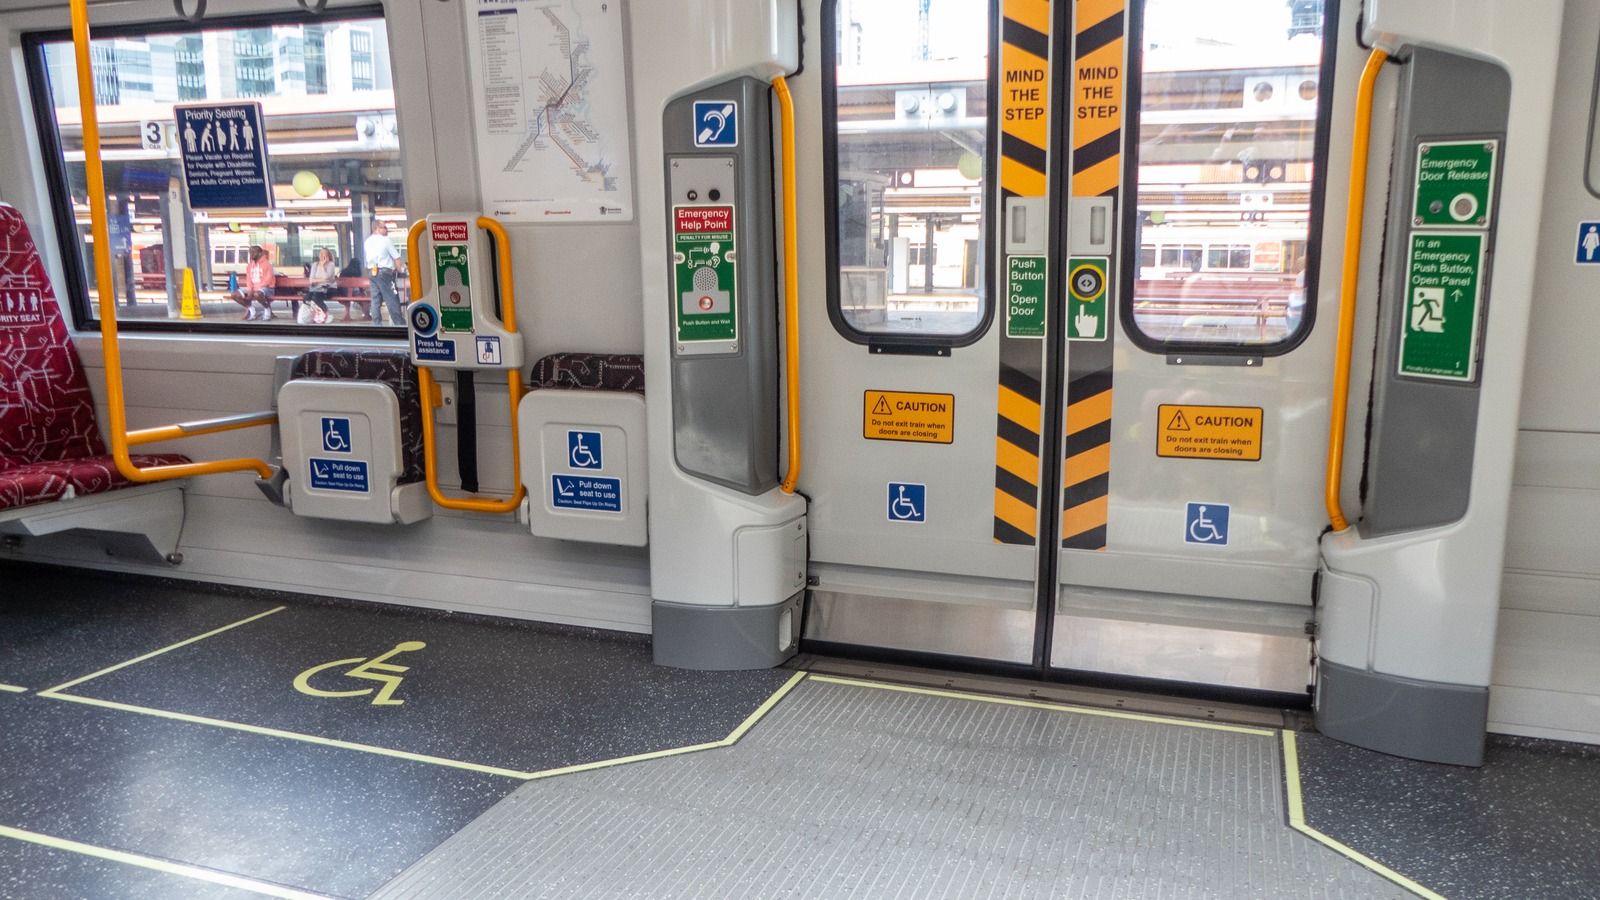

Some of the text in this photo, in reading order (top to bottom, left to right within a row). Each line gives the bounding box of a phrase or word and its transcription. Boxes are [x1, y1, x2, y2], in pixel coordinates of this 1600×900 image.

[1006, 70, 1044, 82] MIND
[1079, 66, 1118, 80] MIND
[1010, 89, 1040, 101] THE
[1082, 86, 1114, 99] THE
[185, 108, 246, 121] Priority Seating
[1006, 108, 1044, 120] STEP
[1078, 106, 1118, 119] STEP
[147, 122, 161, 144] 3
[231, 153, 254, 161] Request
[1421, 158, 1478, 170] Emergency
[210, 170, 234, 178] Pregnant
[1421, 170, 1488, 180] Door Release
[218, 178, 240, 186] Carrying
[678, 210, 728, 220] Emergency
[432, 224, 467, 232] Emergency
[681, 220, 727, 230] Help Point
[434, 232, 449, 240] Help
[1415, 239, 1440, 248] In an
[1414, 251, 1470, 263] Emergency
[1012, 260, 1036, 268] Push
[1413, 263, 1474, 274] Push Button,
[1011, 271, 1044, 280] Button
[1412, 275, 1470, 286] Open Panel
[1011, 283, 1022, 292] To
[1011, 295, 1037, 305] Open
[1011, 307, 1034, 315] Door
[20, 314, 40, 322] SEAT
[896, 402, 946, 412] CAUTION
[1195, 416, 1253, 427] CAUTION
[912, 430, 938, 439] closing
[1214, 447, 1243, 456] closing
[579, 480, 592, 488] Pull
